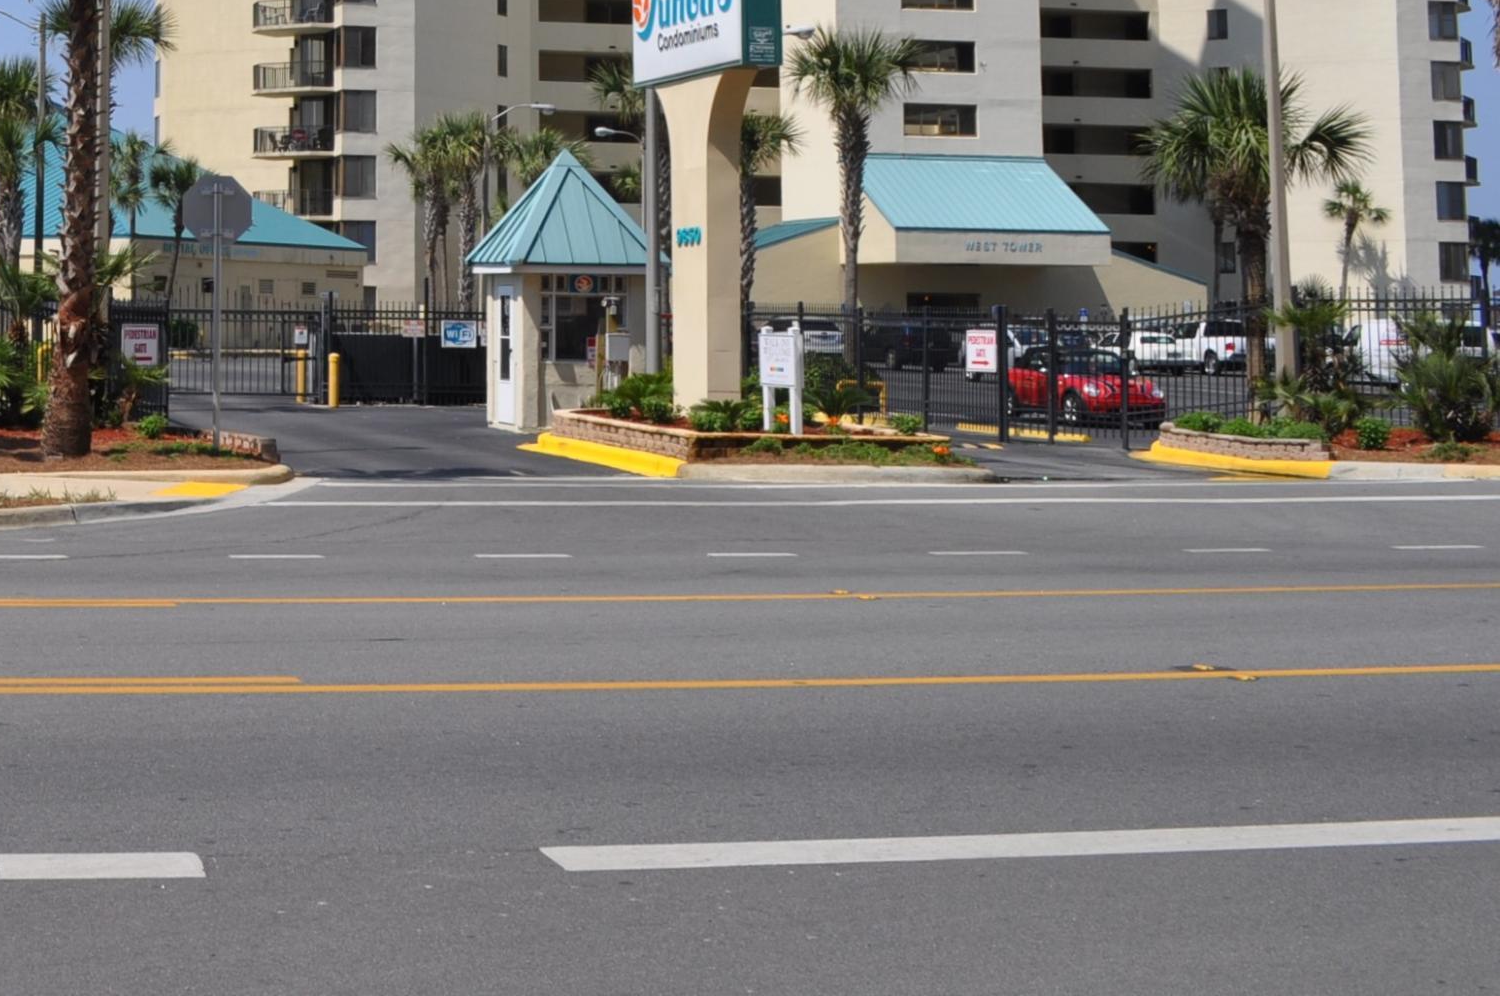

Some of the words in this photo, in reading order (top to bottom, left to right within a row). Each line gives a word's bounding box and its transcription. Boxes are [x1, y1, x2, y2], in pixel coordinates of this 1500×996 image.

[657, 22, 719, 52] Condominiums
[965, 241, 997, 253] WEST
[1002, 241, 1043, 253] TOWER
